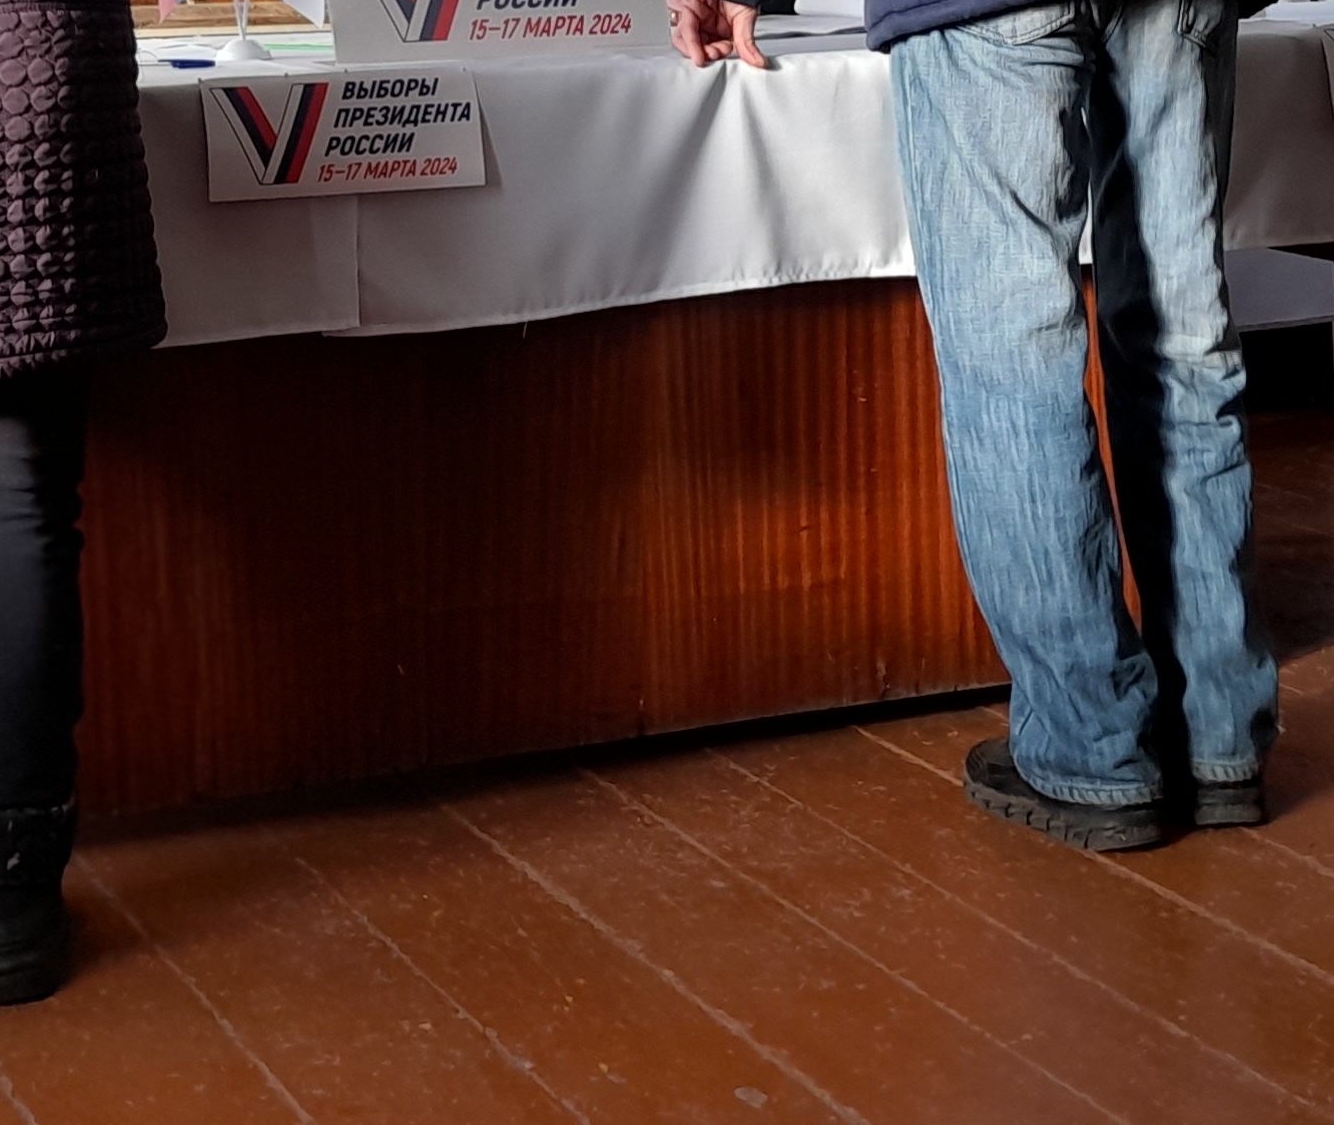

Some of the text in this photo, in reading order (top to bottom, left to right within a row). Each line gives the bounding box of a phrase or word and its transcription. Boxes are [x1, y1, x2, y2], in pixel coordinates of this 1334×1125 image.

[522, 14, 585, 38] МАРТА
[588, 13, 632, 35] 2024
[342, 77, 439, 100] ВЫБОРЫ
[333, 102, 471, 128] ПРЕЗИДЕНТА
[324, 132, 415, 157] РОССИИ
[363, 159, 417, 180] МАРТА
[420, 156, 457, 176] 2024
